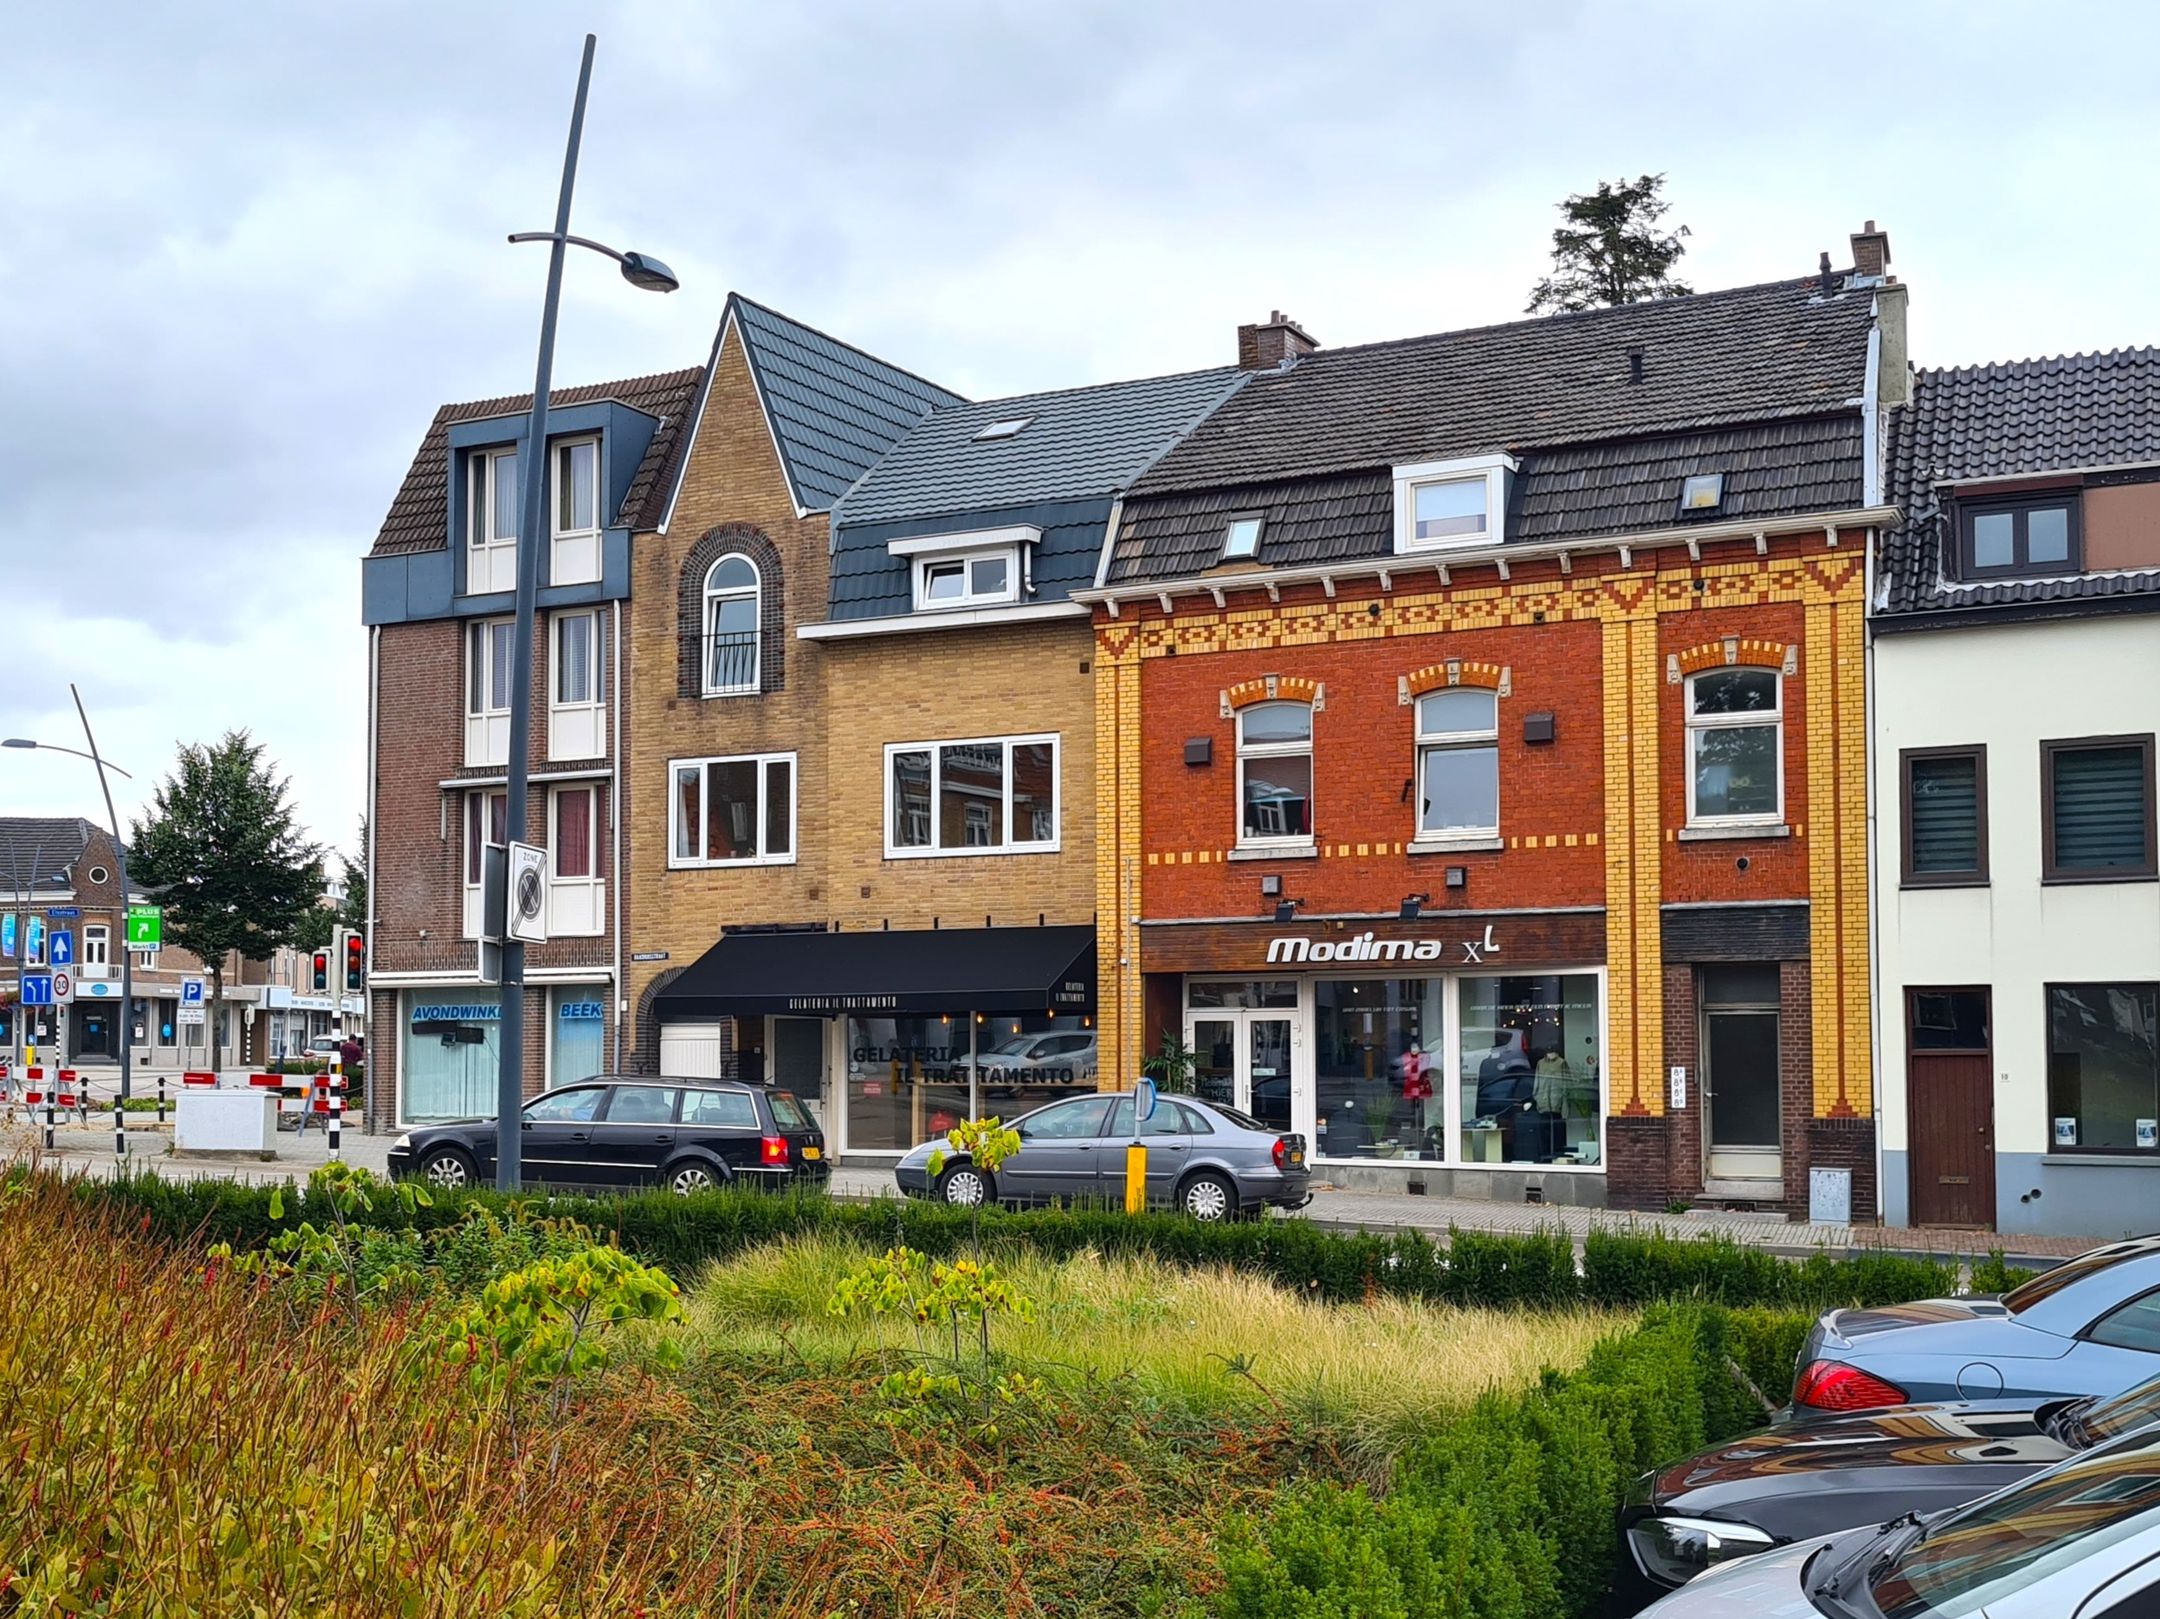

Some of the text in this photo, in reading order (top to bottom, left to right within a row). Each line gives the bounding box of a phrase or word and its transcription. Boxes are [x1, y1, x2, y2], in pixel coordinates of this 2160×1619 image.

[523, 852, 538, 863] ZONE
[789, 996, 896, 1009] GELATERIA IL TRATTAMENTO
[560, 1003, 602, 1017] BEEK
[853, 1046, 961, 1063] GELATERIA
[896, 1067, 915, 1083] IL
